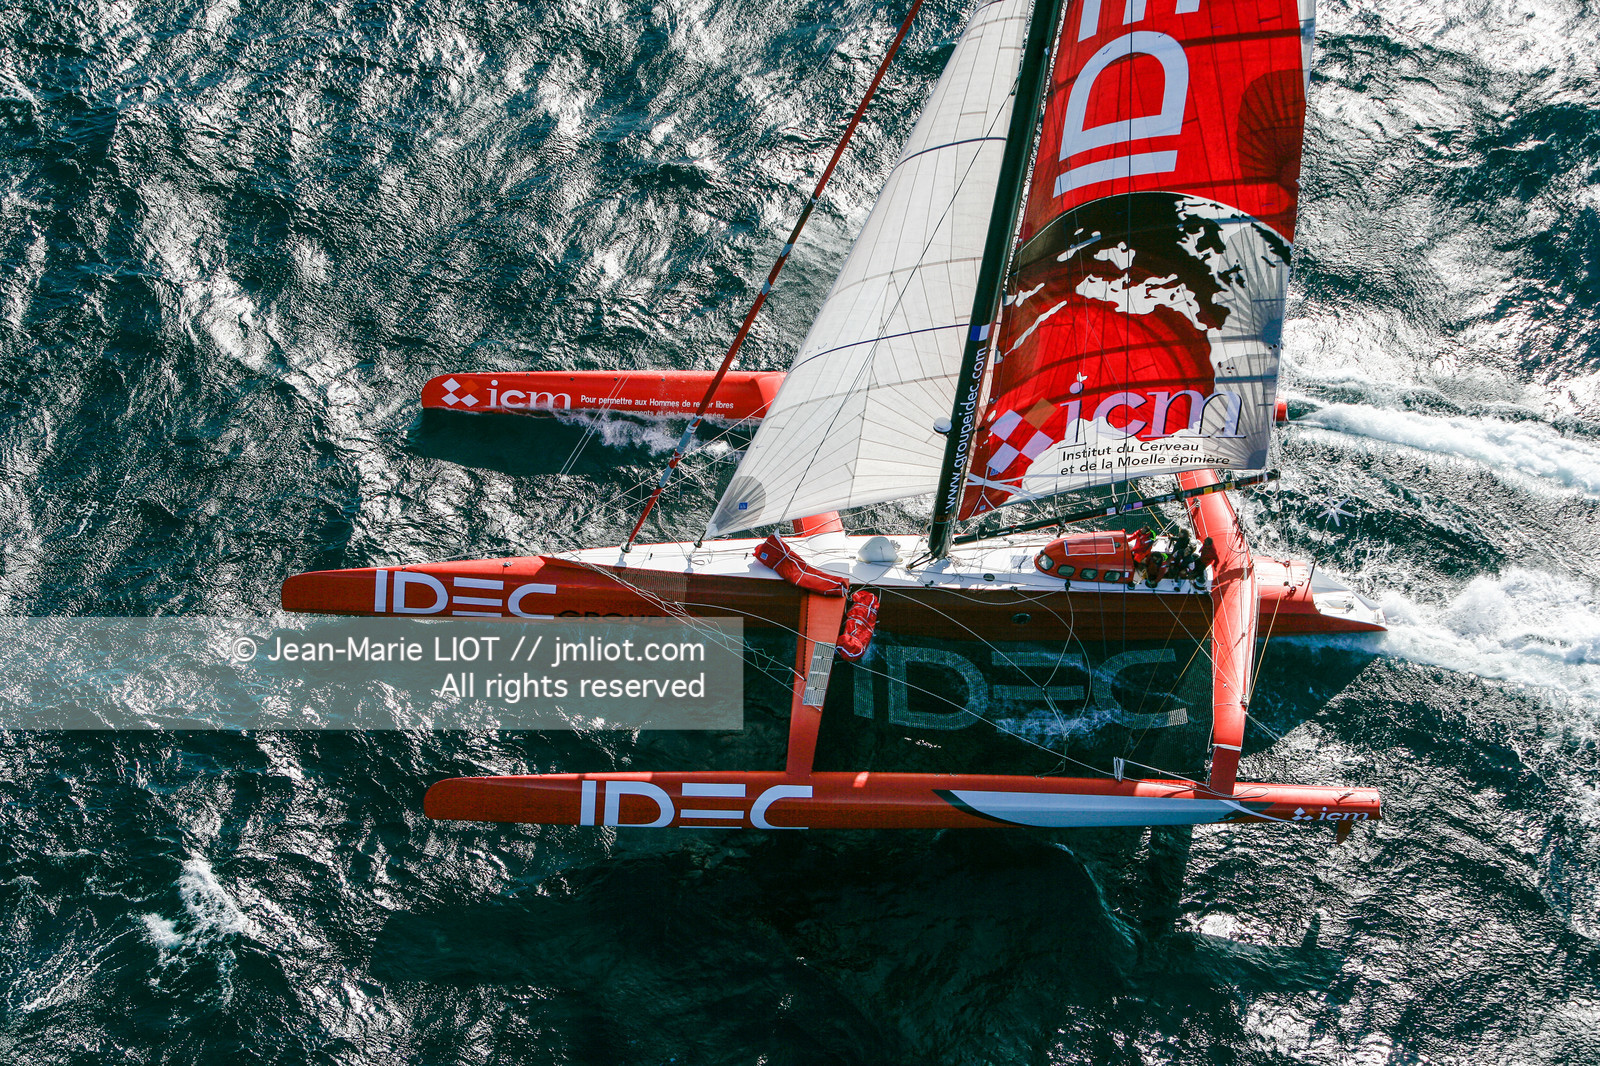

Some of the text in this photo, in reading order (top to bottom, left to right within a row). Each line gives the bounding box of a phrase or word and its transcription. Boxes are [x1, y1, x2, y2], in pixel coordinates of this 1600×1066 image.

[487, 380, 572, 410] icm
[580, 395, 597, 404] Pour
[598, 396, 632, 406] permettre
[649, 398, 680, 407] Hommes
[682, 400, 691, 408] de
[715, 401, 734, 409] libres
[946, 347, 987, 511] www.groupeidec.com
[1058, 382, 1247, 449] icm
[1060, 453, 1230, 476] et de la Moelle épinière
[1062, 441, 1199, 462] Institut du Cerveau
[374, 570, 557, 620] IDEC
[853, 645, 1188, 733] IDEC
[579, 780, 813, 829] IDEC
[1318, 806, 1369, 821] icm
